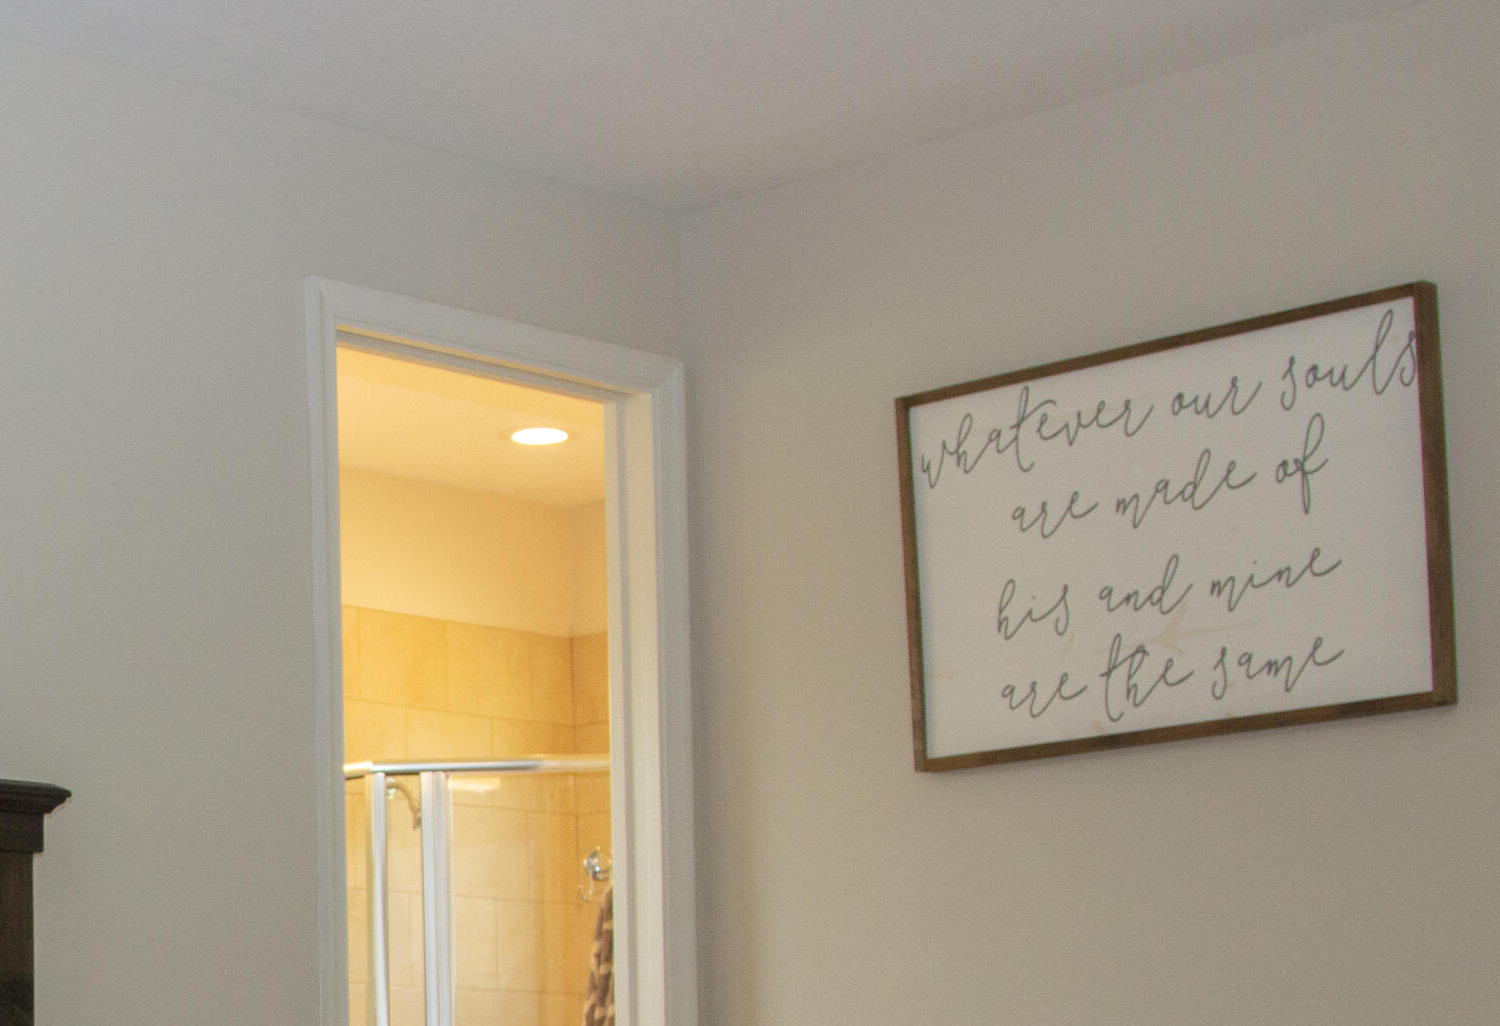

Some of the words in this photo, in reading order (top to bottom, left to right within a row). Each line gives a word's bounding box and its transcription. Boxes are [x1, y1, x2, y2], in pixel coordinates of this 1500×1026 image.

[921, 385, 1155, 489] whatever
[1171, 374, 1264, 416] our
[1280, 308, 1417, 411] souls
[1011, 490, 1100, 539] are
[1115, 448, 1258, 529] made
[1275, 413, 1330, 515] of
[996, 578, 1070, 641] his
[1099, 553, 1193, 616] and
[1209, 546, 1343, 612] mine
[1001, 671, 1089, 718] are
[1099, 632, 1194, 723] the
[1212, 636, 1346, 700] same
